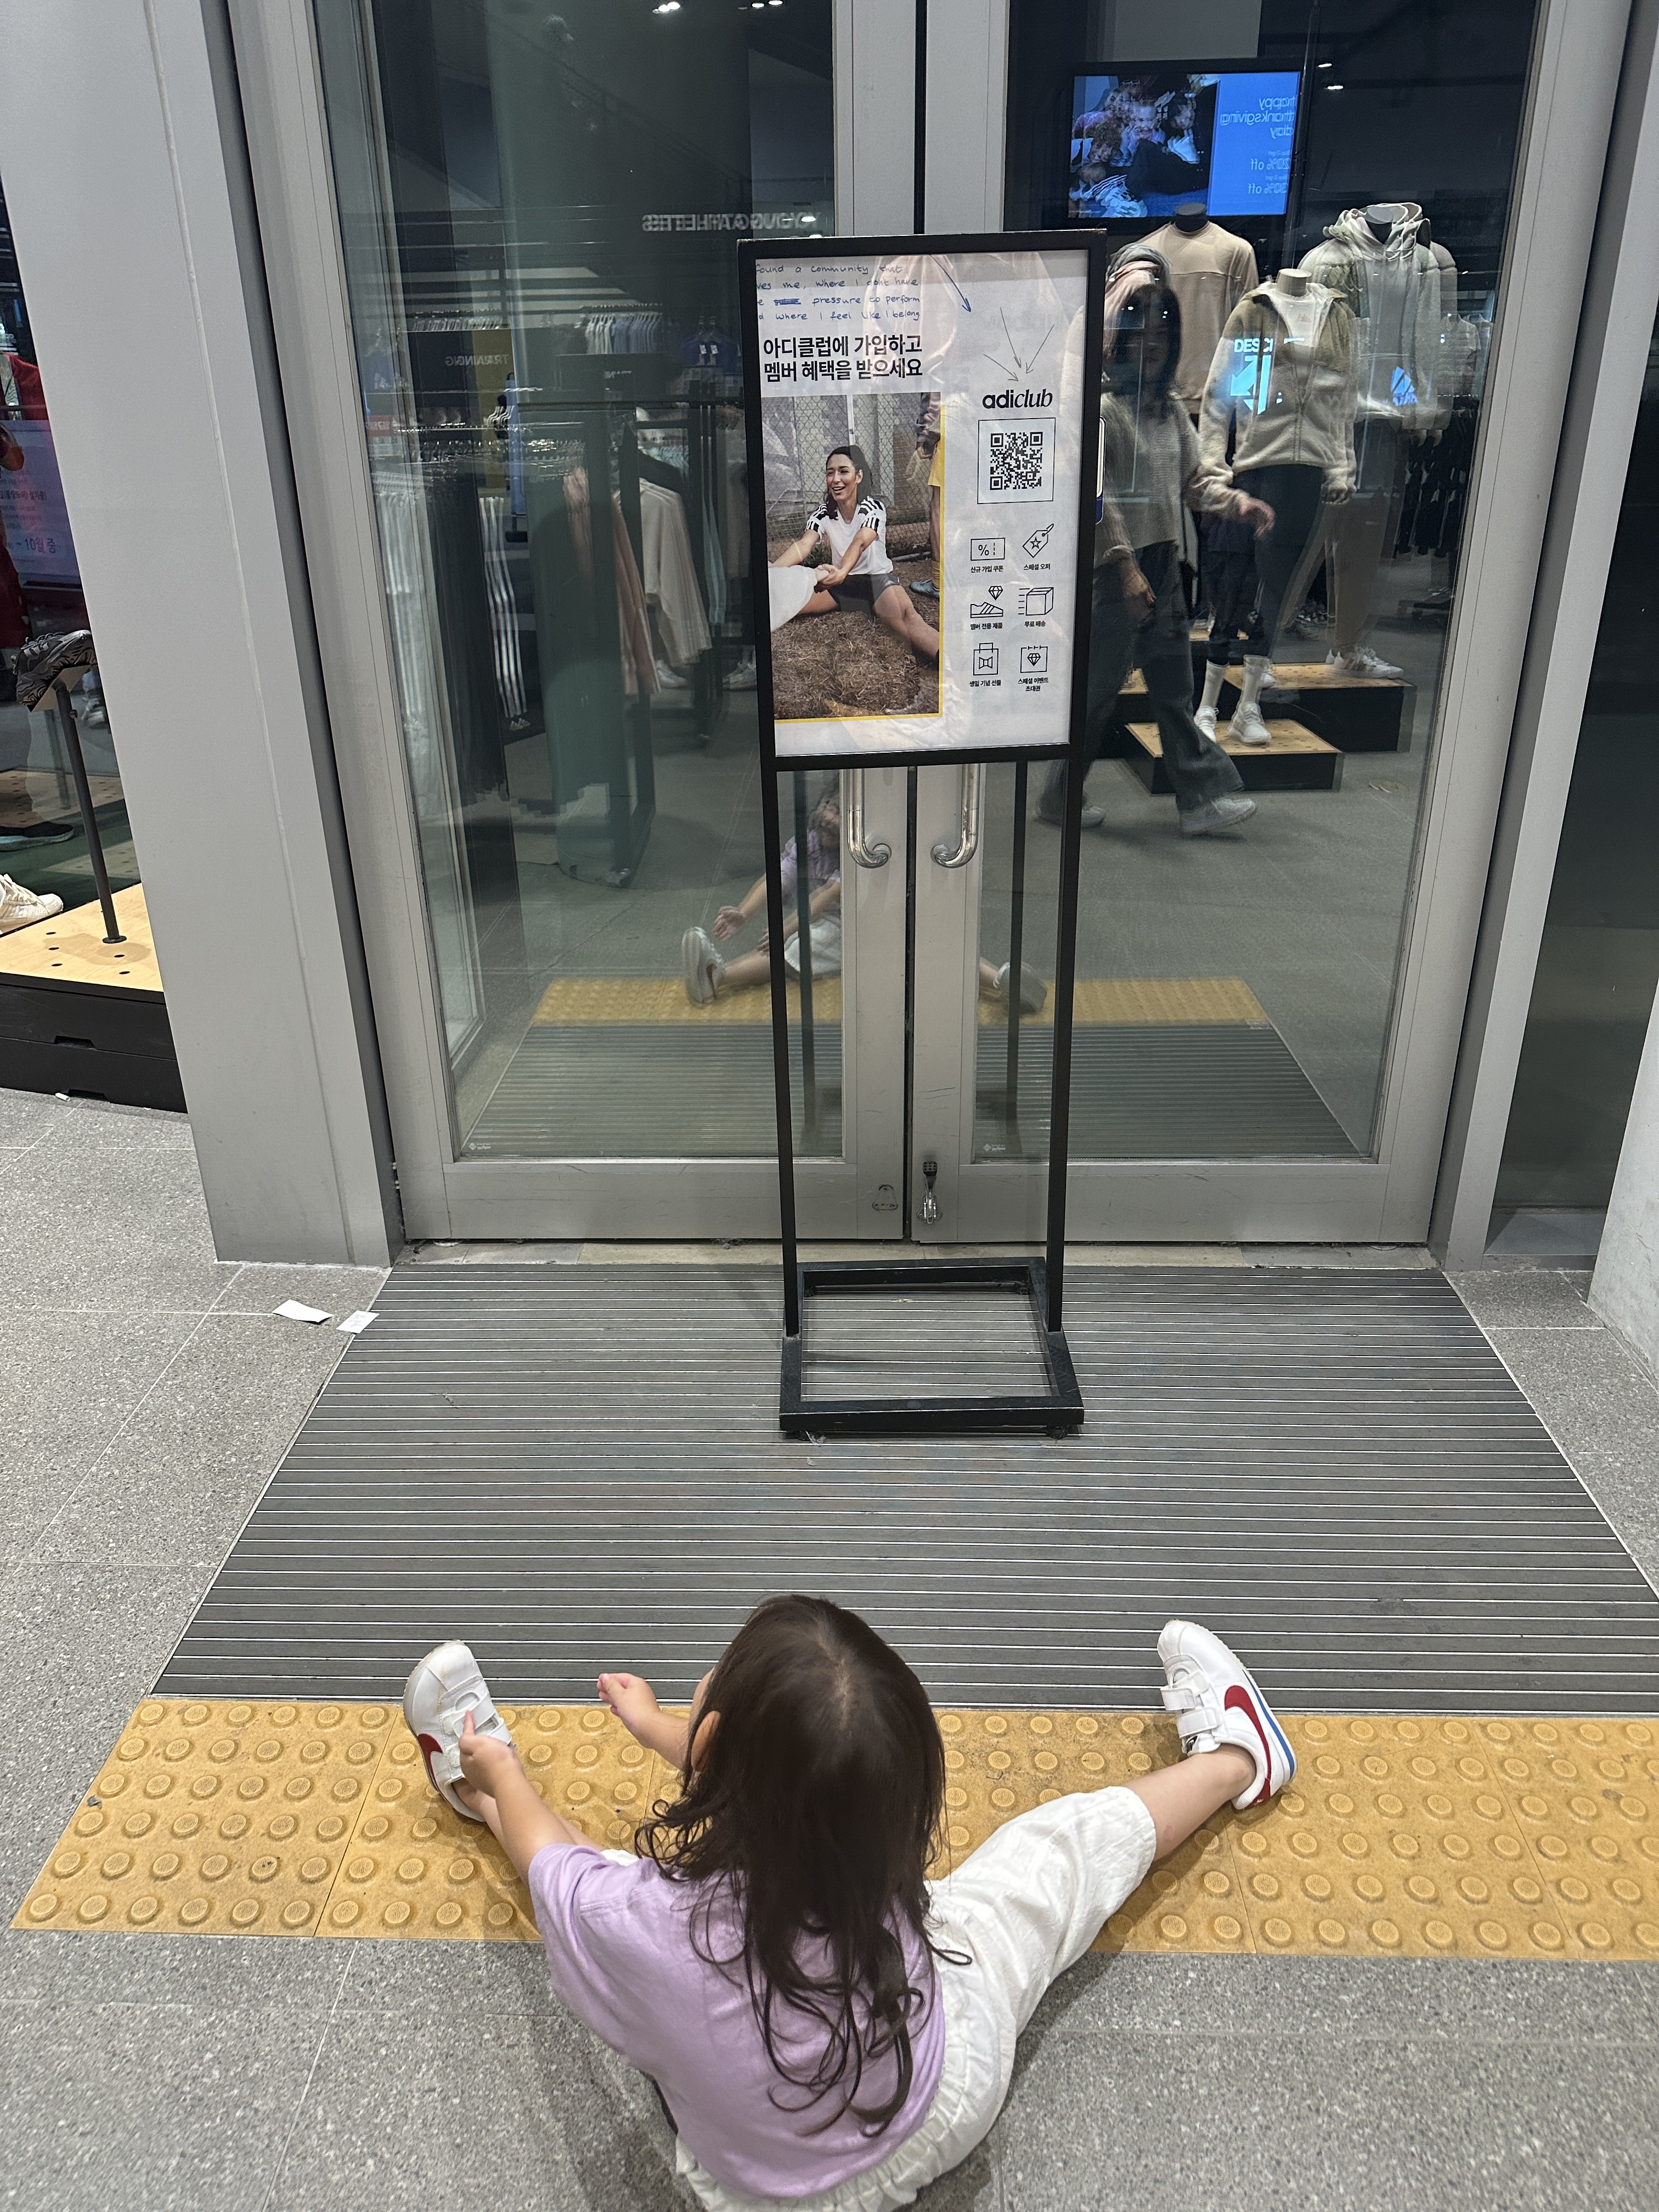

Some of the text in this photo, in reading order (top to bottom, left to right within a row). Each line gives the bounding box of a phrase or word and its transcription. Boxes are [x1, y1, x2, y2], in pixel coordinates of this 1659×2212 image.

[810, 264, 868, 274] community
[878, 265, 903, 273] that
[894, 276, 919, 286] have
[812, 297, 861, 307] pressure
[885, 295, 921, 306] perform
[830, 311, 851, 320] feel
[861, 311, 881, 320] like
[892, 309, 921, 321] belong
[763, 334, 922, 358] 아디클럽에 가입하고
[764, 358, 923, 382] 멤버 혜택을 받으세요
[982, 388, 1053, 409] adiclub
